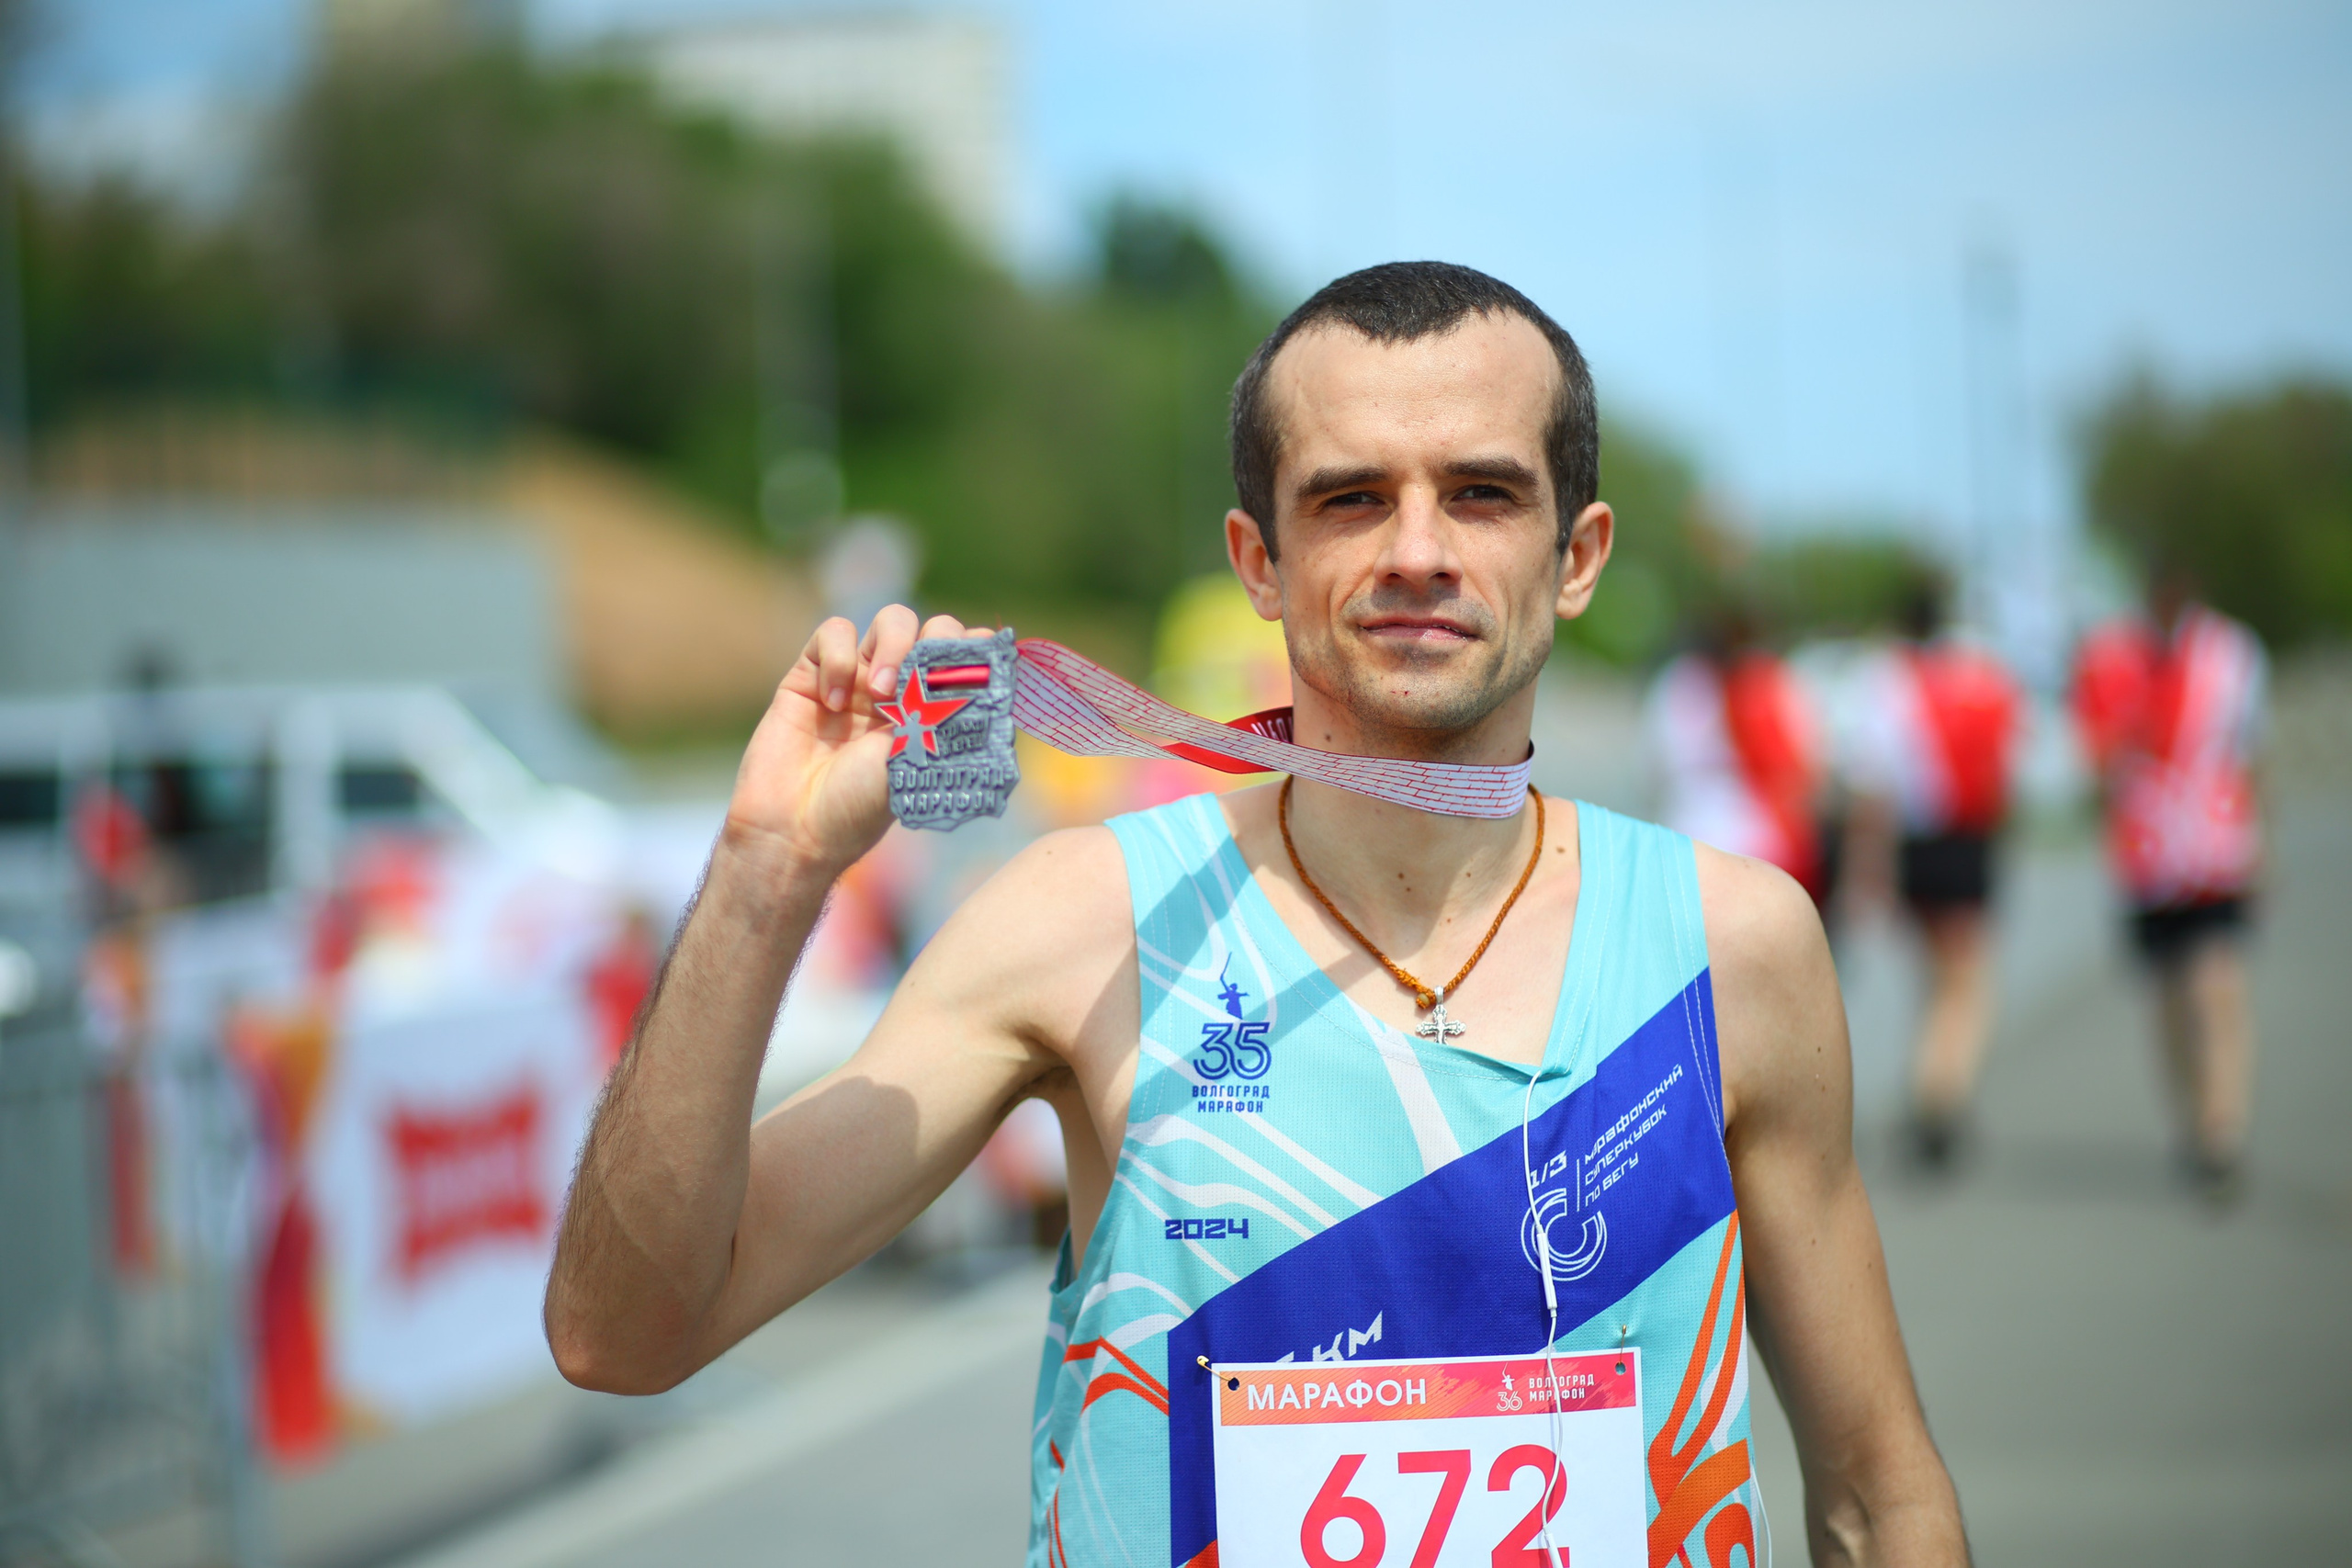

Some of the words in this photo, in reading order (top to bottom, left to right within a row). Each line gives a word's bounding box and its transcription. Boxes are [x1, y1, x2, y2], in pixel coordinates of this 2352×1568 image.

[894, 766, 1005, 791] ВОЛГОГРАД
[903, 791, 996, 816] МАРАФОН
[1193, 1021, 1272, 1080] 35
[1192, 1085, 1271, 1100] ВОЛГОГРАД
[1197, 1100, 1263, 1113] МАРАФОН
[1602, 1152, 1639, 1191] БЕГУ
[1164, 1218, 1250, 1240] 2024
[1248, 1378, 1427, 1411] МАРАФОН
[1496, 1391, 1523, 1412] 36
[1300, 1443, 1570, 1568] 672
